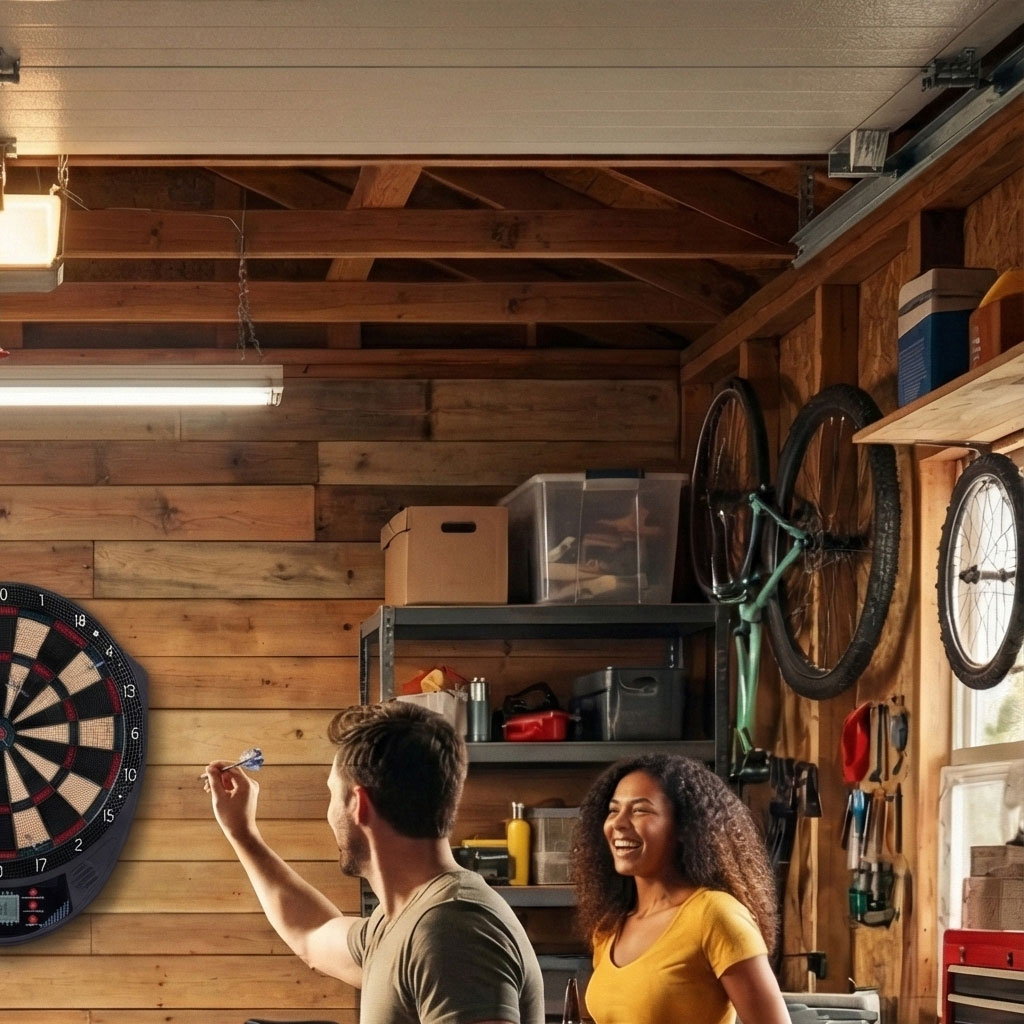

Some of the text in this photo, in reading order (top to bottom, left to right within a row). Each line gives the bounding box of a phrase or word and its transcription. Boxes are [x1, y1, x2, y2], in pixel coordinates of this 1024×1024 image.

[38, 593, 45, 606] 1
[74, 614, 86, 628] 18
[123, 684, 136, 698] 13
[131, 726, 139, 740] 6
[124, 767, 137, 782] 10
[103, 808, 115, 823] 15
[74, 838, 83, 852] 2
[35, 857, 47, 872] 17
